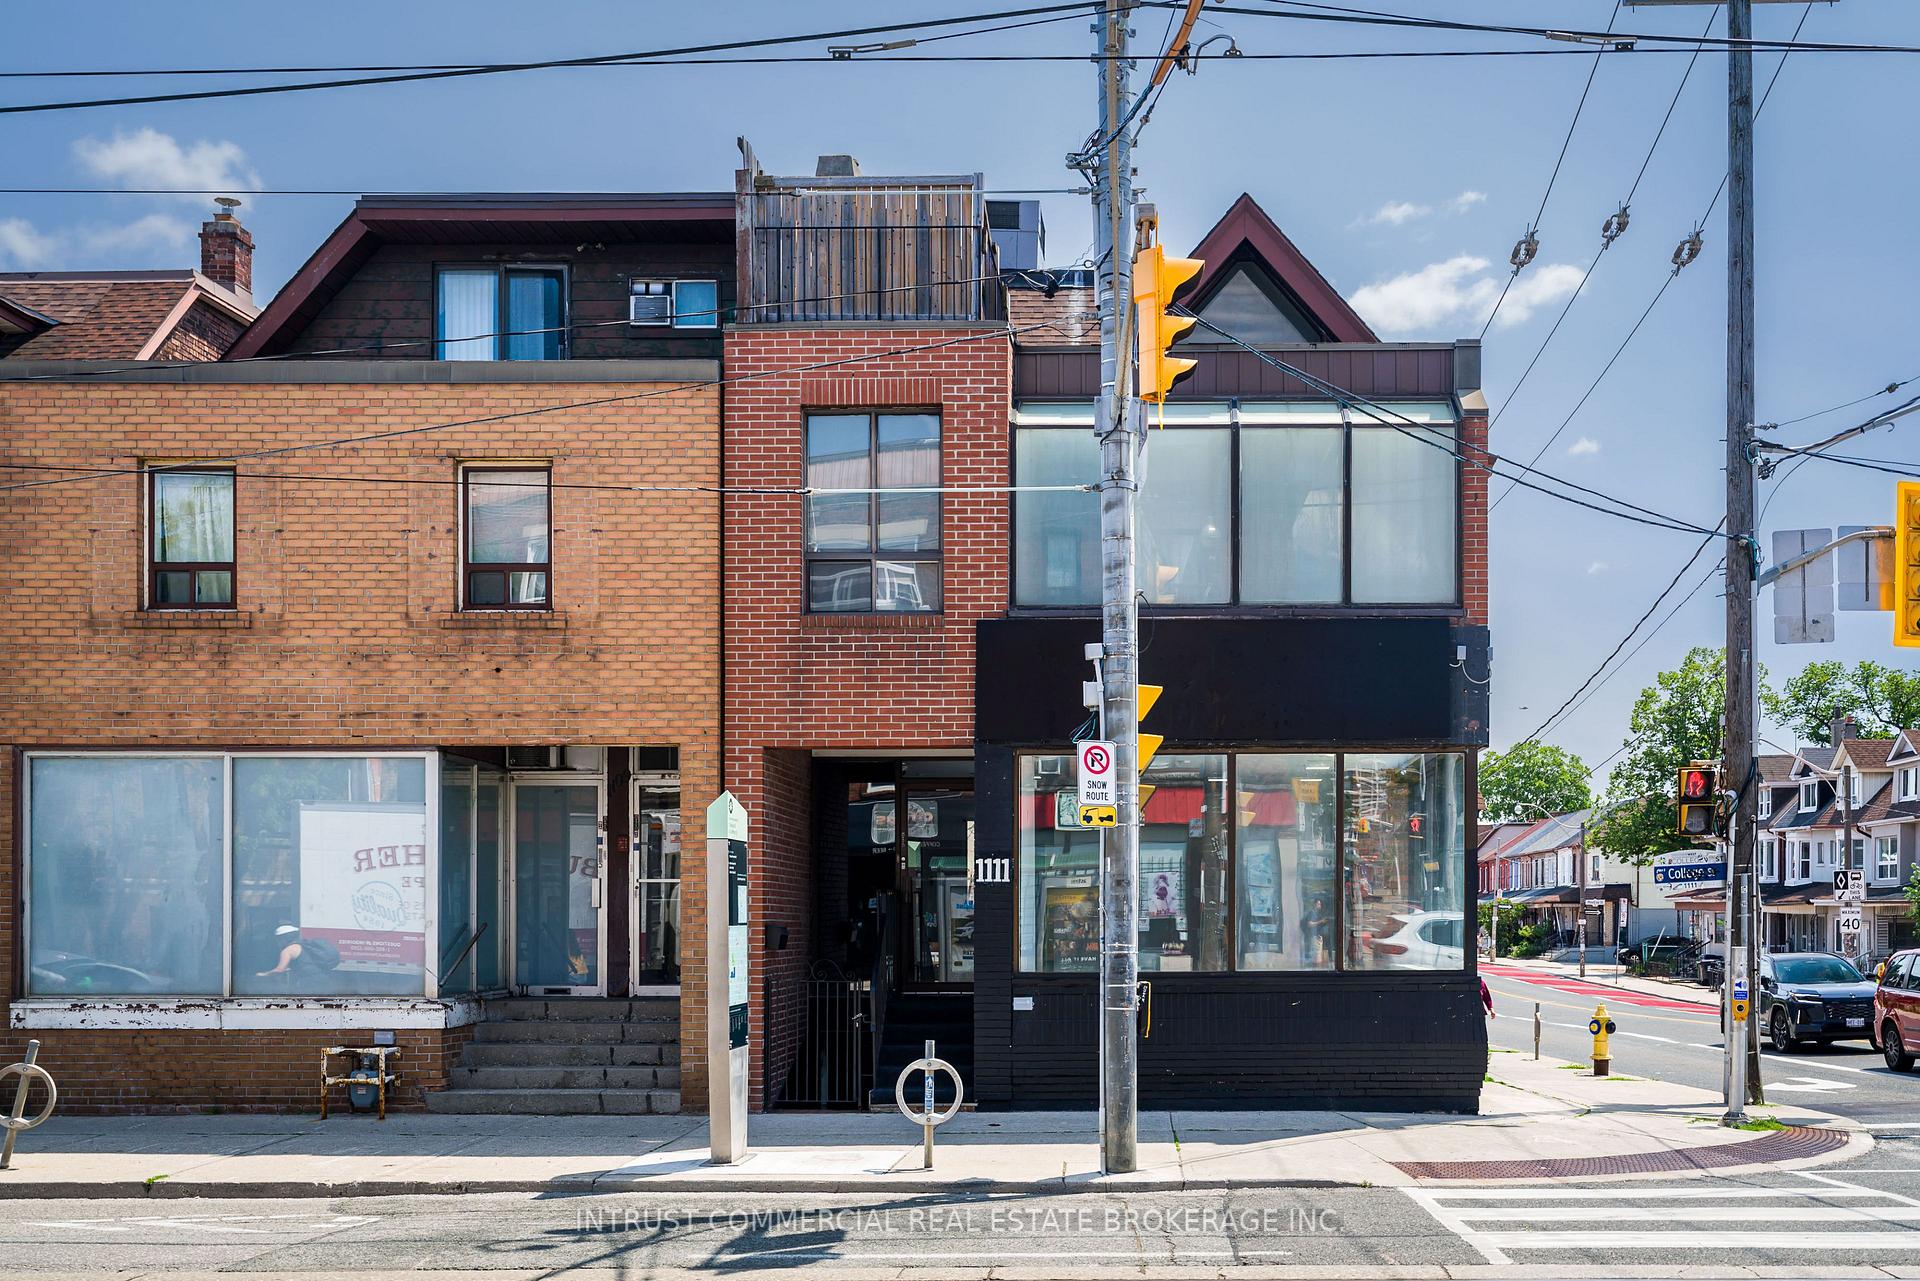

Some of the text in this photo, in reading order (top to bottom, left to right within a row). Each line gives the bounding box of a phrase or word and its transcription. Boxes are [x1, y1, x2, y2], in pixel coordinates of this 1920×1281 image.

[1087, 780, 1107, 790] SNOW
[1085, 791, 1109, 801] ROUTE
[975, 858, 1011, 883] 1111
[1841, 918, 1860, 930] 40
